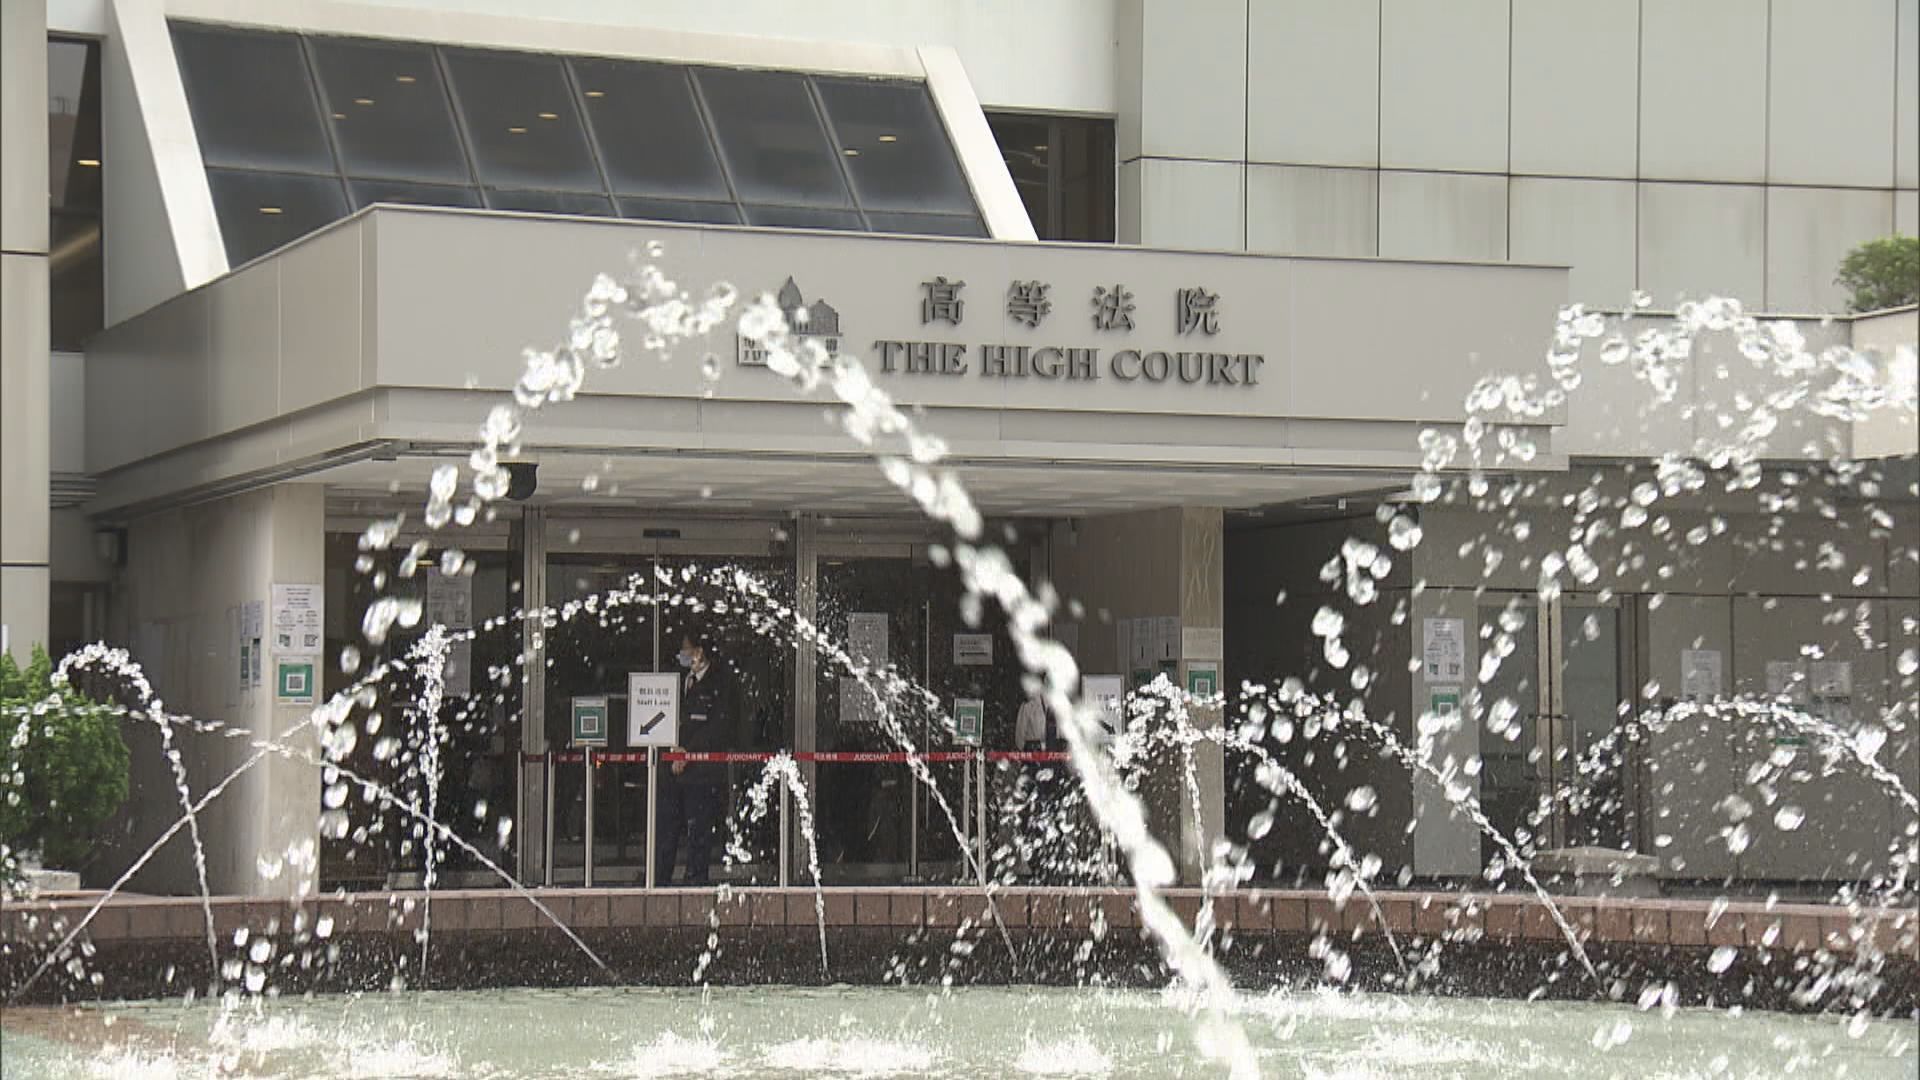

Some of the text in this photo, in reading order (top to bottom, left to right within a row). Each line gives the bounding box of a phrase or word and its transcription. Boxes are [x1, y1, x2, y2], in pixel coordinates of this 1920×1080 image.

[921, 275, 1221, 335] 高等法院
[873, 339, 968, 377] THE
[979, 342, 1102, 380] HIGH
[1110, 348, 1265, 386] COURT
[726, 753, 763, 761] JUDICIARY
[853, 753, 890, 761] JUDICIARY
